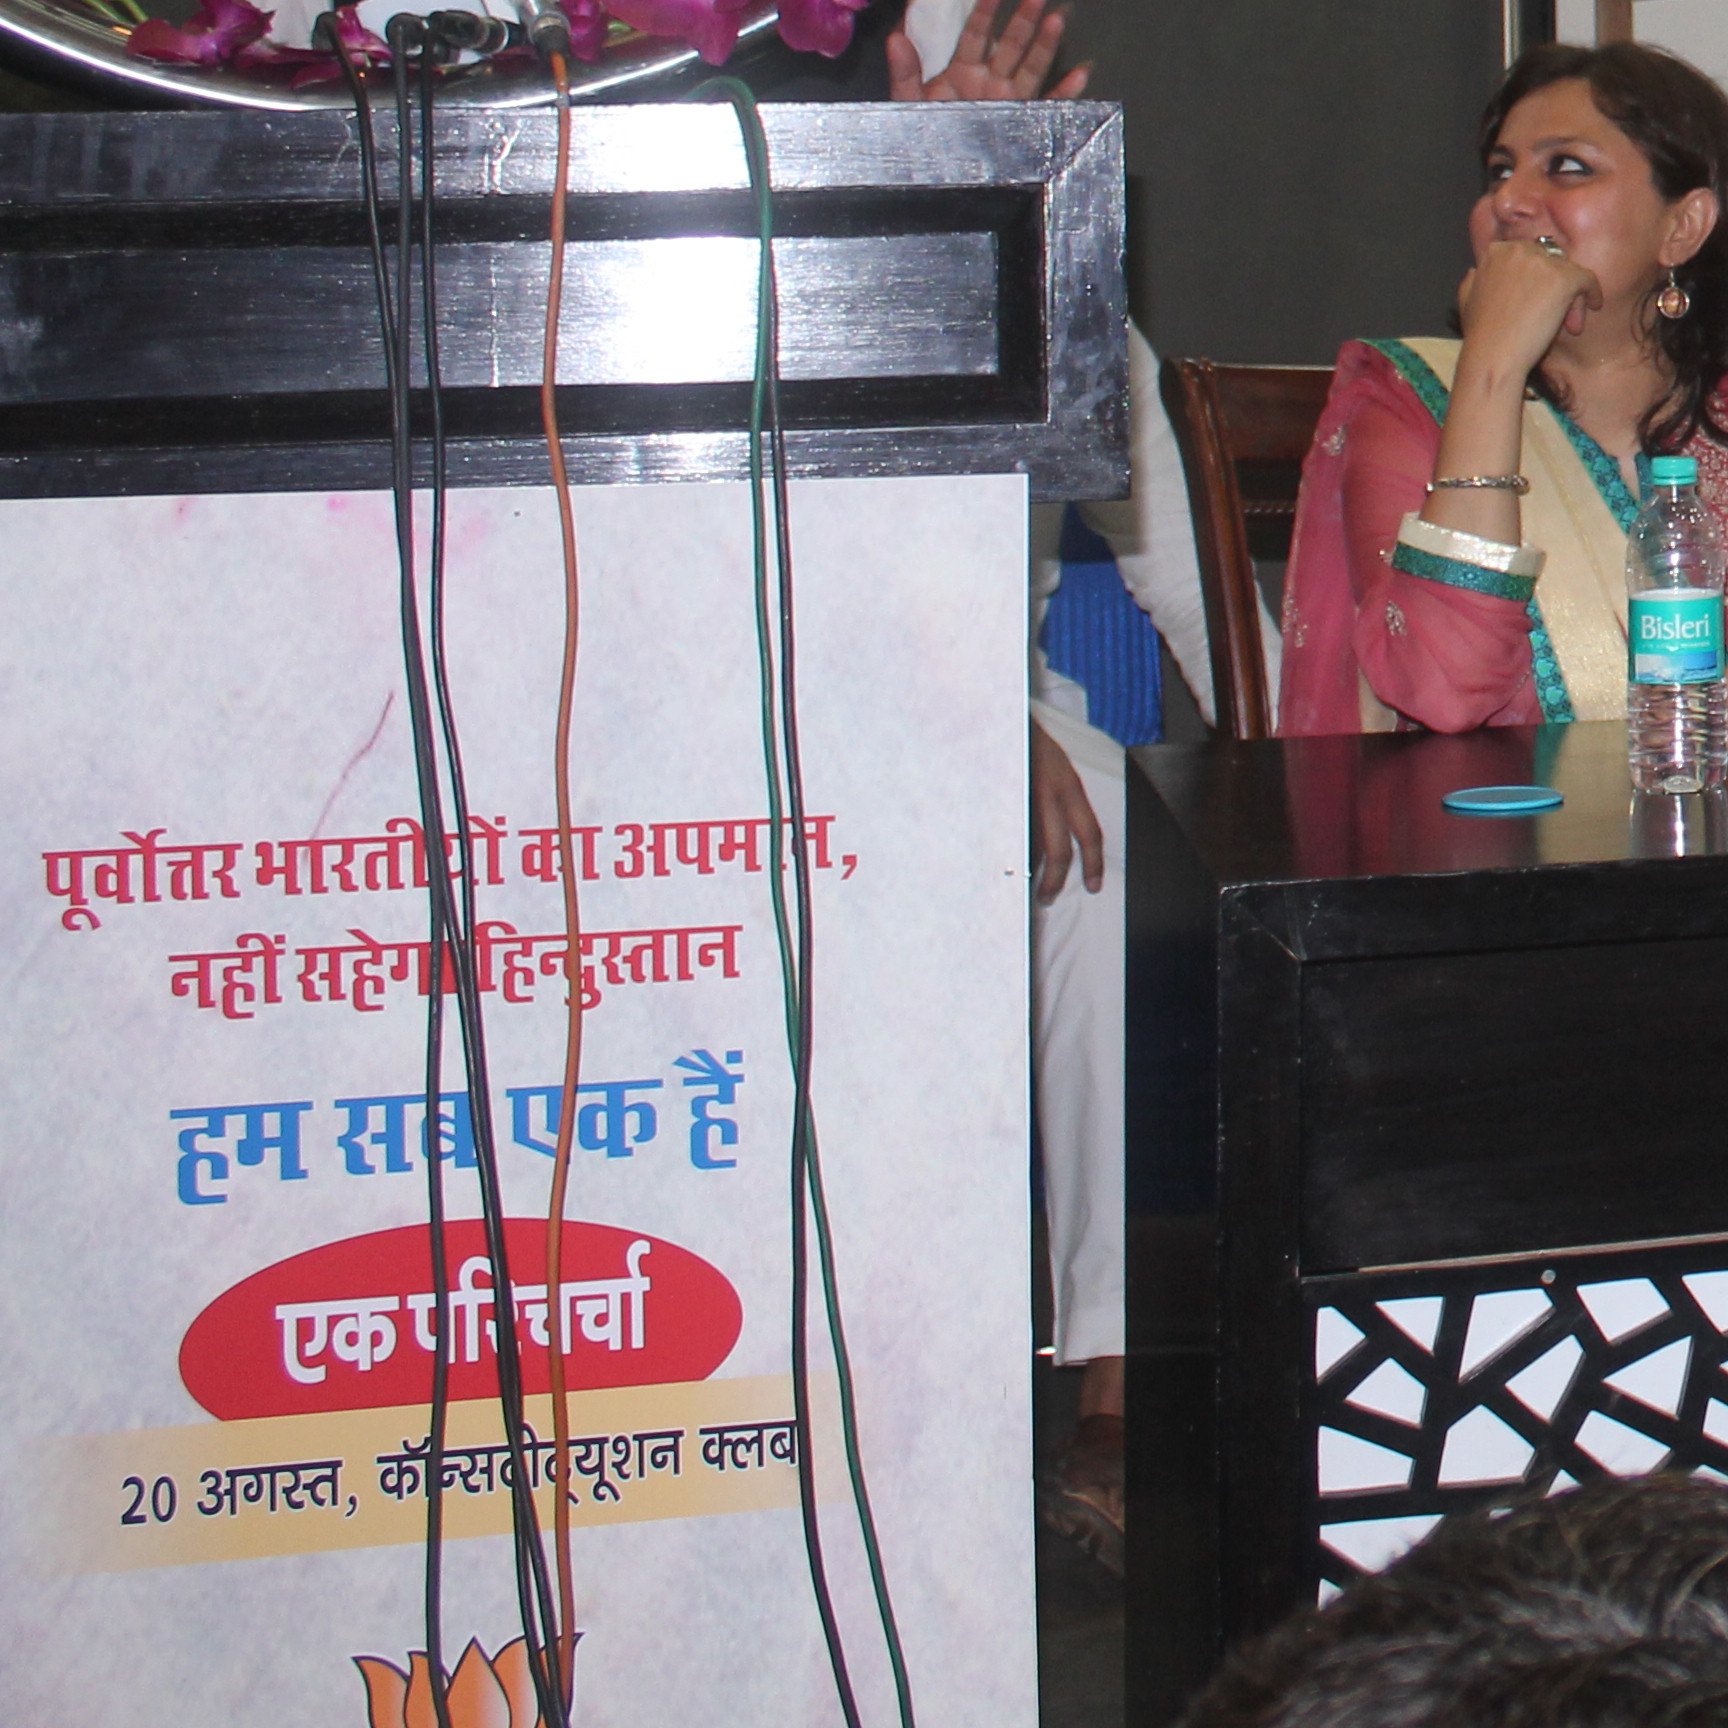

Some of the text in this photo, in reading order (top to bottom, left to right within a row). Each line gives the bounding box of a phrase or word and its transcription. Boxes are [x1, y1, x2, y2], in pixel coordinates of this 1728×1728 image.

[1641, 613, 1710, 640] Bisleri
[42, 828, 243, 931] पूर्वोत्तर
[518, 826, 603, 881] का
[613, 815, 858, 880] अपमन,
[168, 933, 286, 1019] नहीं
[170, 1049, 745, 1205] हम सब एक हैं
[275, 1295, 400, 1384] एक
[120, 1475, 176, 1526] 20
[197, 1458, 359, 1517] अगस्त,
[699, 1419, 798, 1471] क्लब
